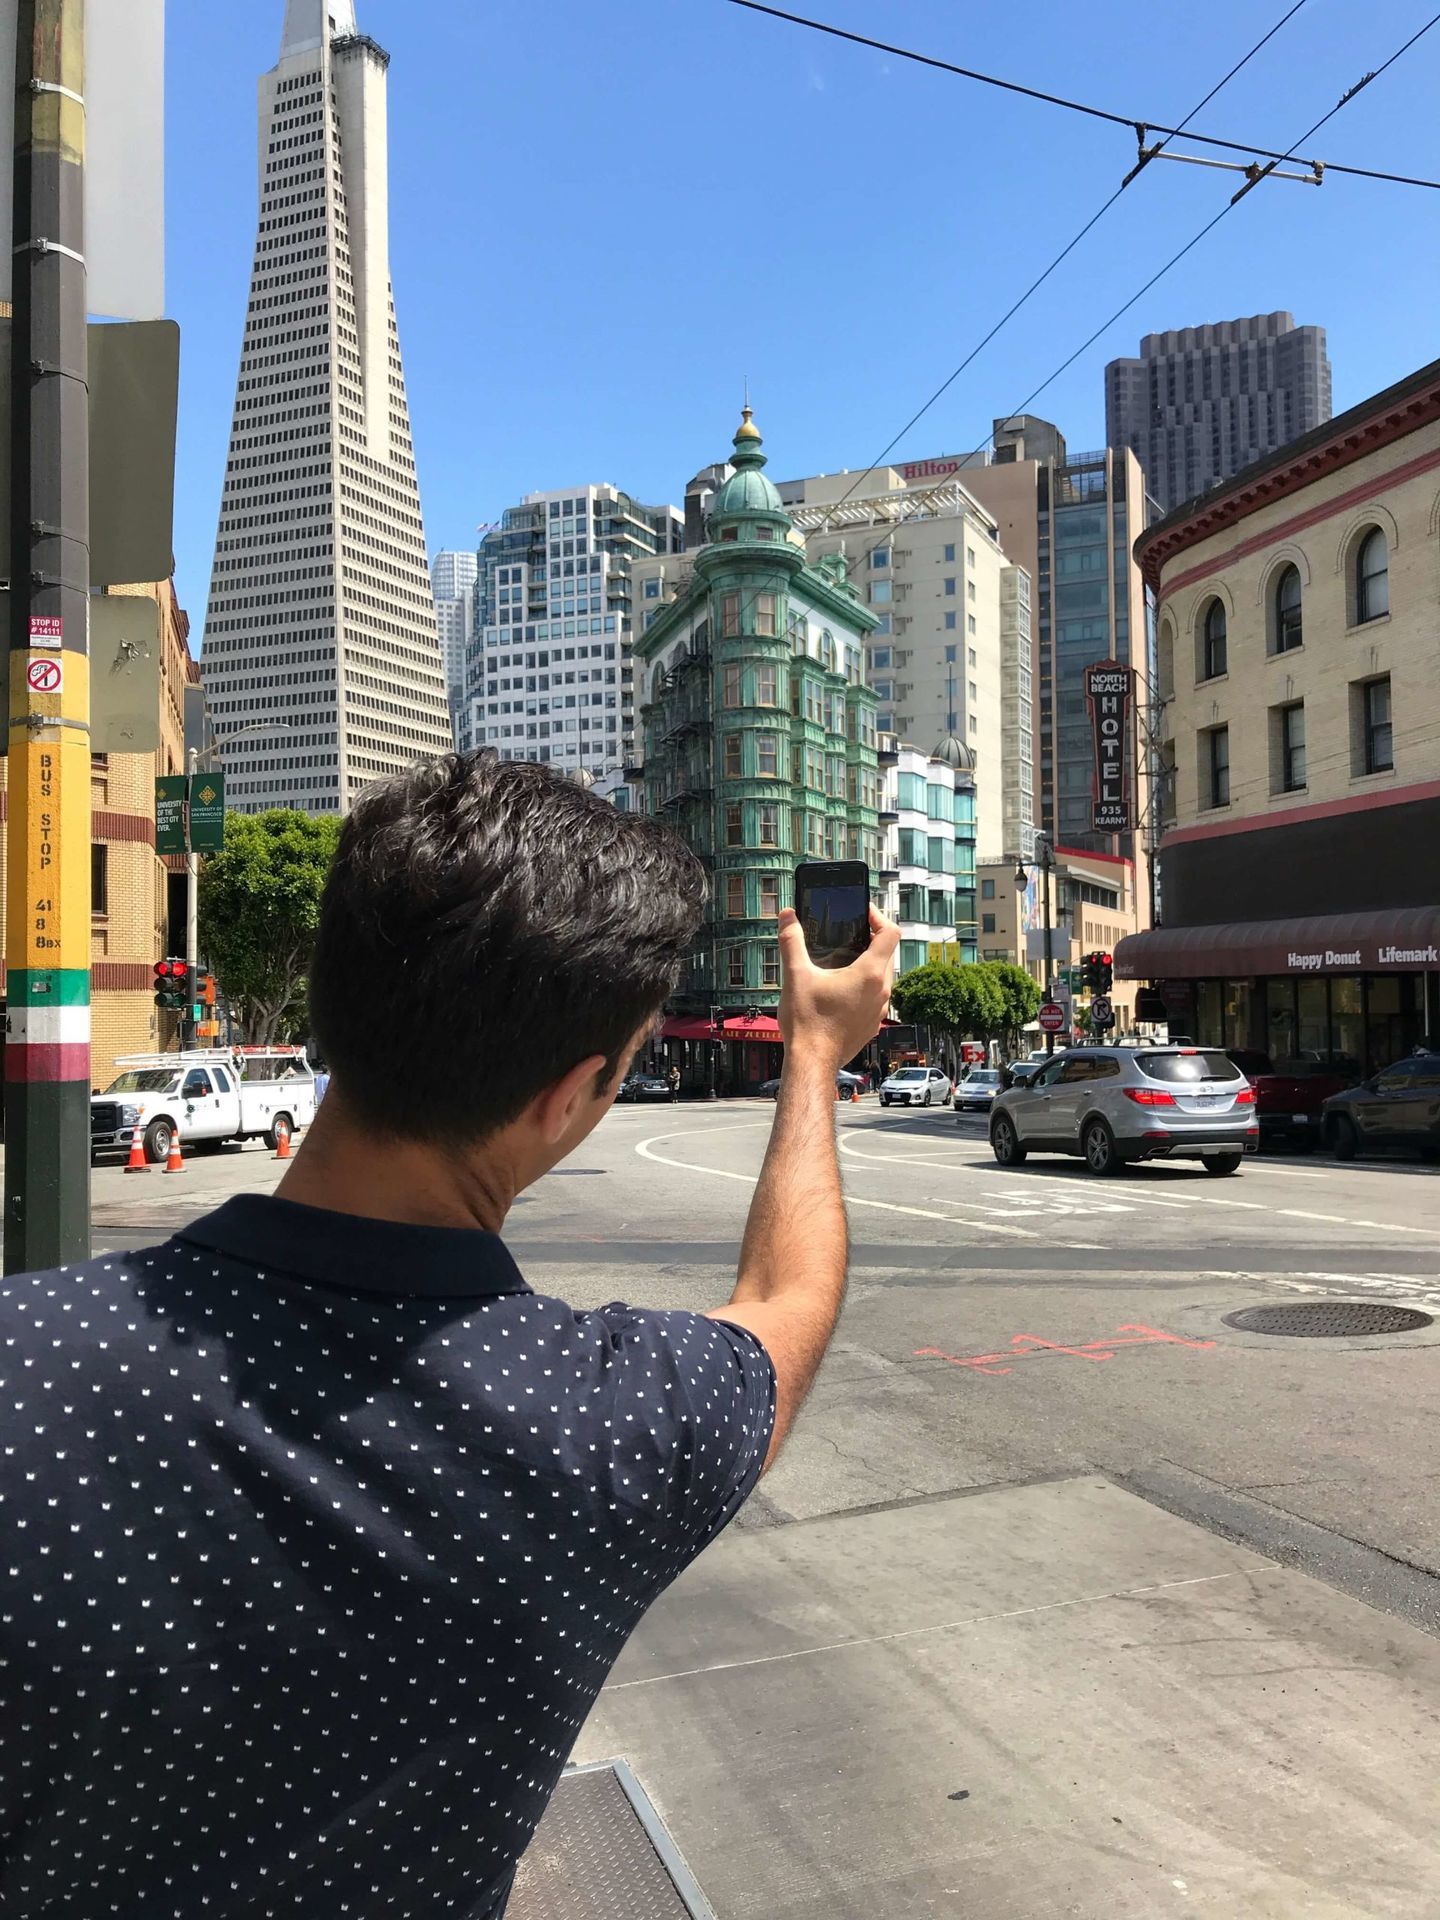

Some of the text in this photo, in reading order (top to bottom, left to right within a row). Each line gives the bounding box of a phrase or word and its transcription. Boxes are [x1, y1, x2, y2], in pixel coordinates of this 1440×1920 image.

[904, 461, 957, 479] Hilton
[31, 618, 60, 627] STOP ID
[1090, 674, 1127, 684] NORTH
[1090, 683, 1127, 693] BEACH
[1101, 696, 1120, 801] HOTEL
[40, 754, 52, 796] BUS
[157, 809, 164, 817] OF
[1101, 806, 1121, 815] 935
[157, 817, 169, 825] BEST
[1095, 816, 1127, 825] KEARNY
[40, 814, 52, 870] STOP
[36, 900, 52, 912] 41
[36, 918, 46, 930] 8
[1287, 950, 1362, 970] Happy Donut
[1378, 945, 1438, 963] Lifemark
